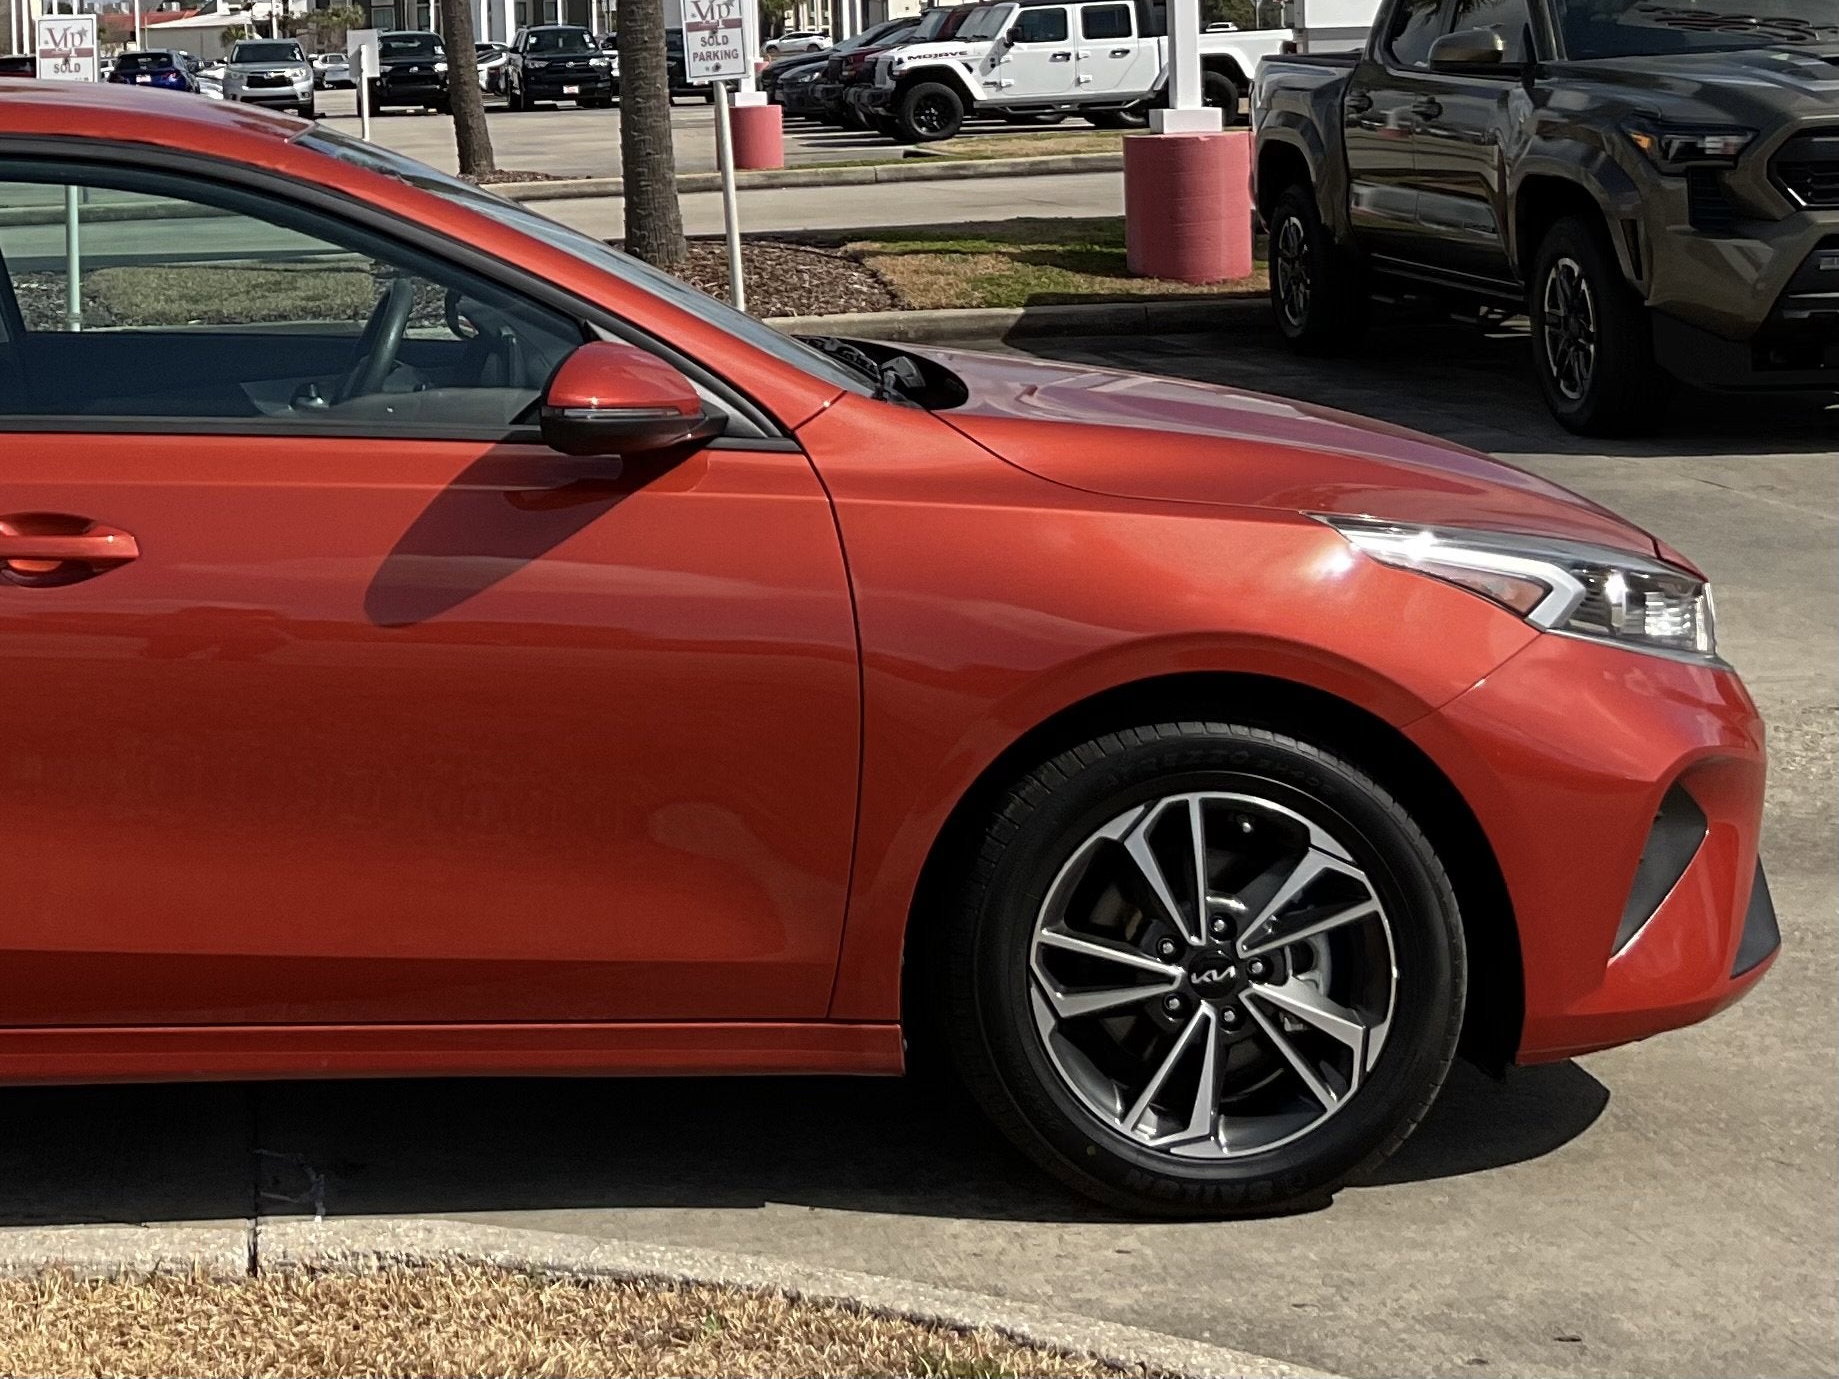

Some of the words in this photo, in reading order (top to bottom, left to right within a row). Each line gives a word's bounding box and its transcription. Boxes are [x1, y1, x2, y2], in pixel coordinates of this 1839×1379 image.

[700, 35, 730, 47] SOLD
[692, 49, 740, 62] PARKING
[907, 51, 969, 61] MOJAVE
[53, 63, 81, 74] SOLD
